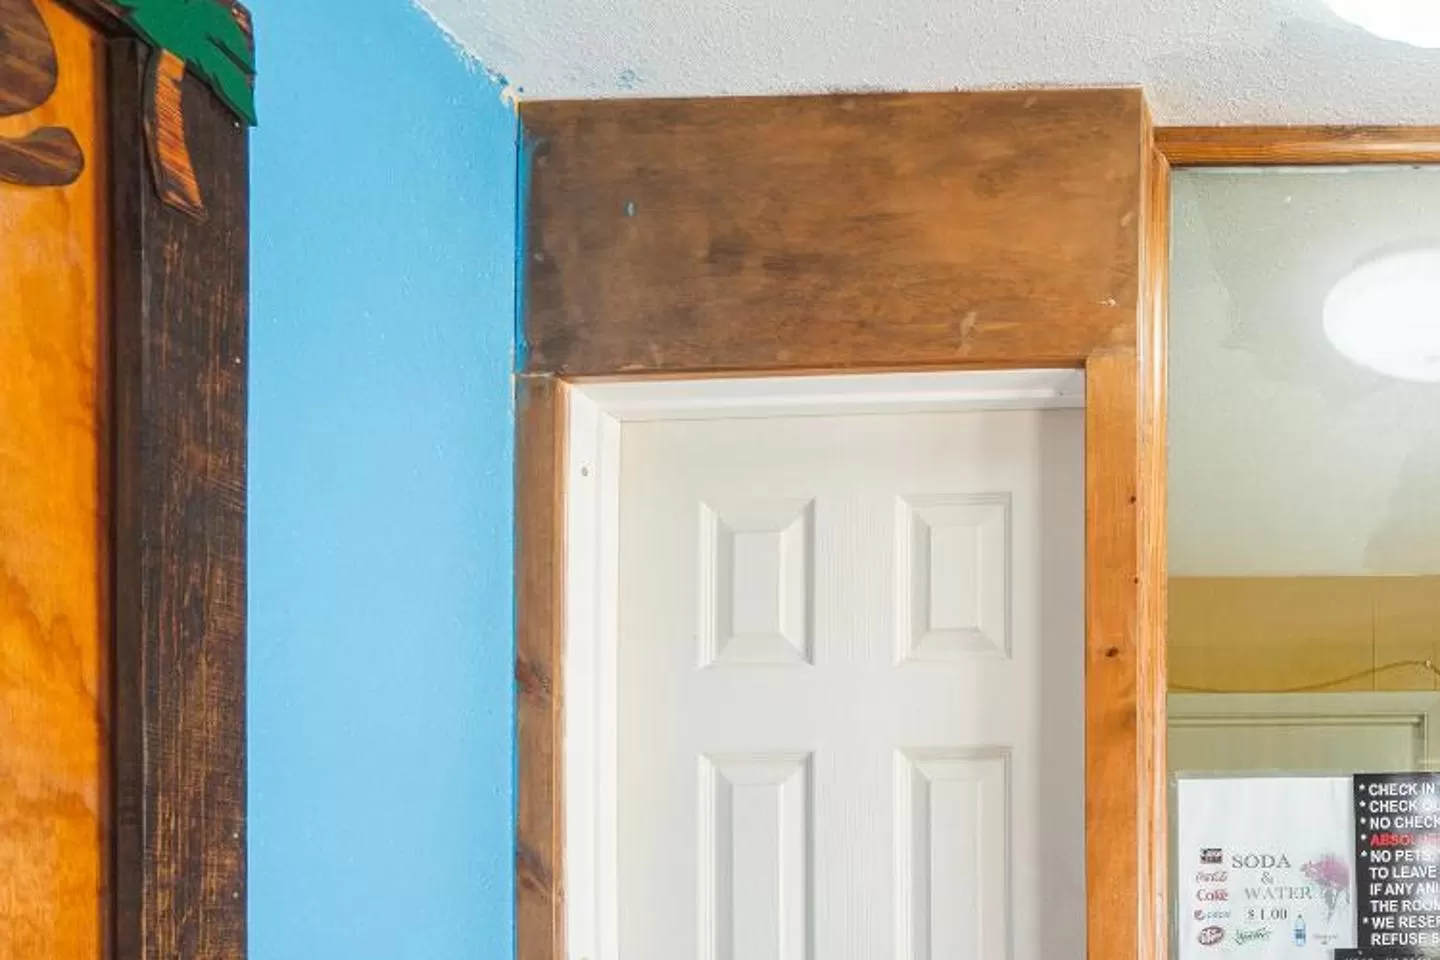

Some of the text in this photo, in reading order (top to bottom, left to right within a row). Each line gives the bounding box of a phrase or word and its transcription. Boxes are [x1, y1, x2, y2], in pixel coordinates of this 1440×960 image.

[1368, 783, 1418, 796] CHECK
[1422, 783, 1435, 795] IN
[1369, 800, 1418, 813] CHECK
[1369, 816, 1391, 830] NO
[1231, 853, 1291, 869] SODA
[1369, 850, 1391, 863] NO
[1260, 871, 1274, 885] &
[1369, 866, 1389, 880] TO
[1392, 865, 1437, 879] LEAVE
[1244, 886, 1313, 900] WATER
[1369, 883, 1383, 896] IF
[1384, 882, 1414, 895] ANY
[1370, 900, 1399, 913] THE
[1371, 916, 1395, 930] WE
[1371, 932, 1427, 946] REFUSE
